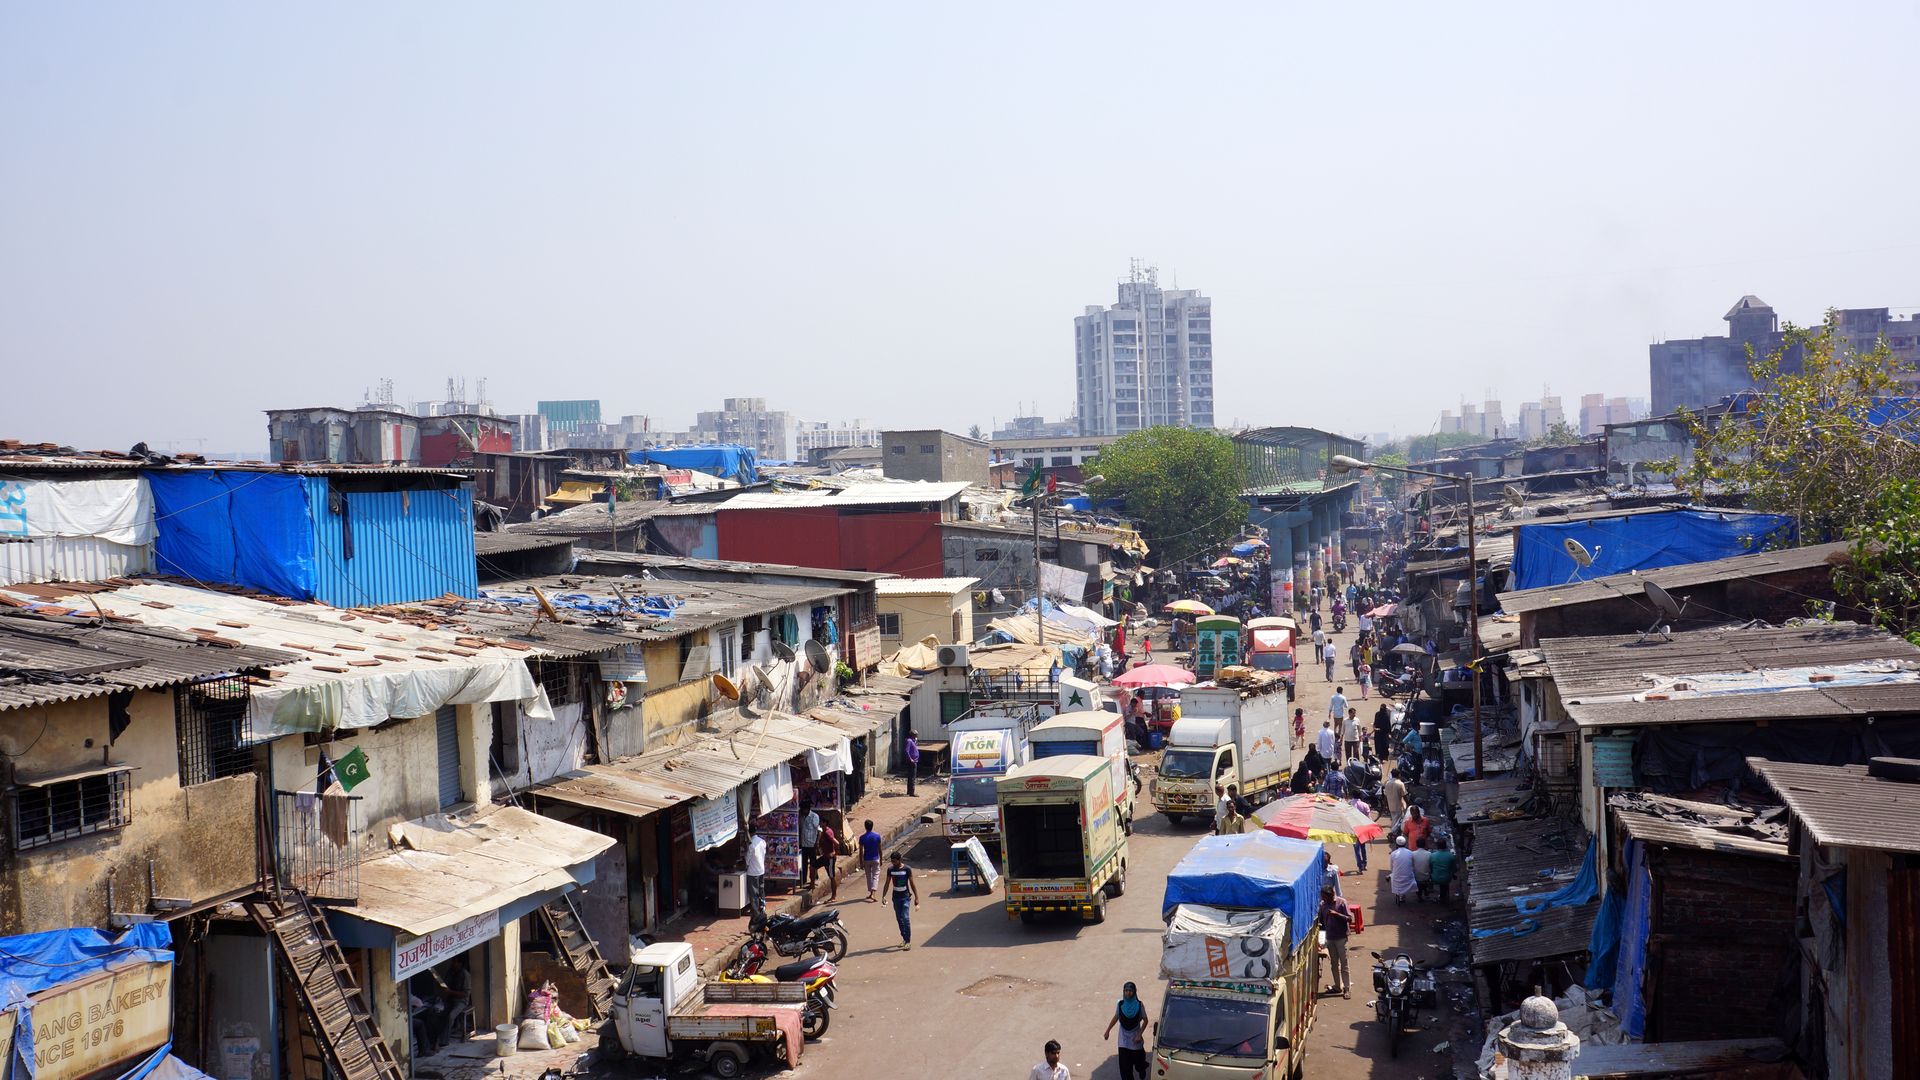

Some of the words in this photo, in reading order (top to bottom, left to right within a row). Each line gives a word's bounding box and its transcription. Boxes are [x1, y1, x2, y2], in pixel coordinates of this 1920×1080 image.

[965, 739, 995, 750] KGN
[398, 934, 432, 968] राजश्री
[1208, 945, 1227, 977] EW
[33, 1011, 82, 1045] ANG
[88, 979, 167, 1024] BAKERY
[35, 1037, 74, 1069] NCE
[81, 1018, 124, 1051] 1976
